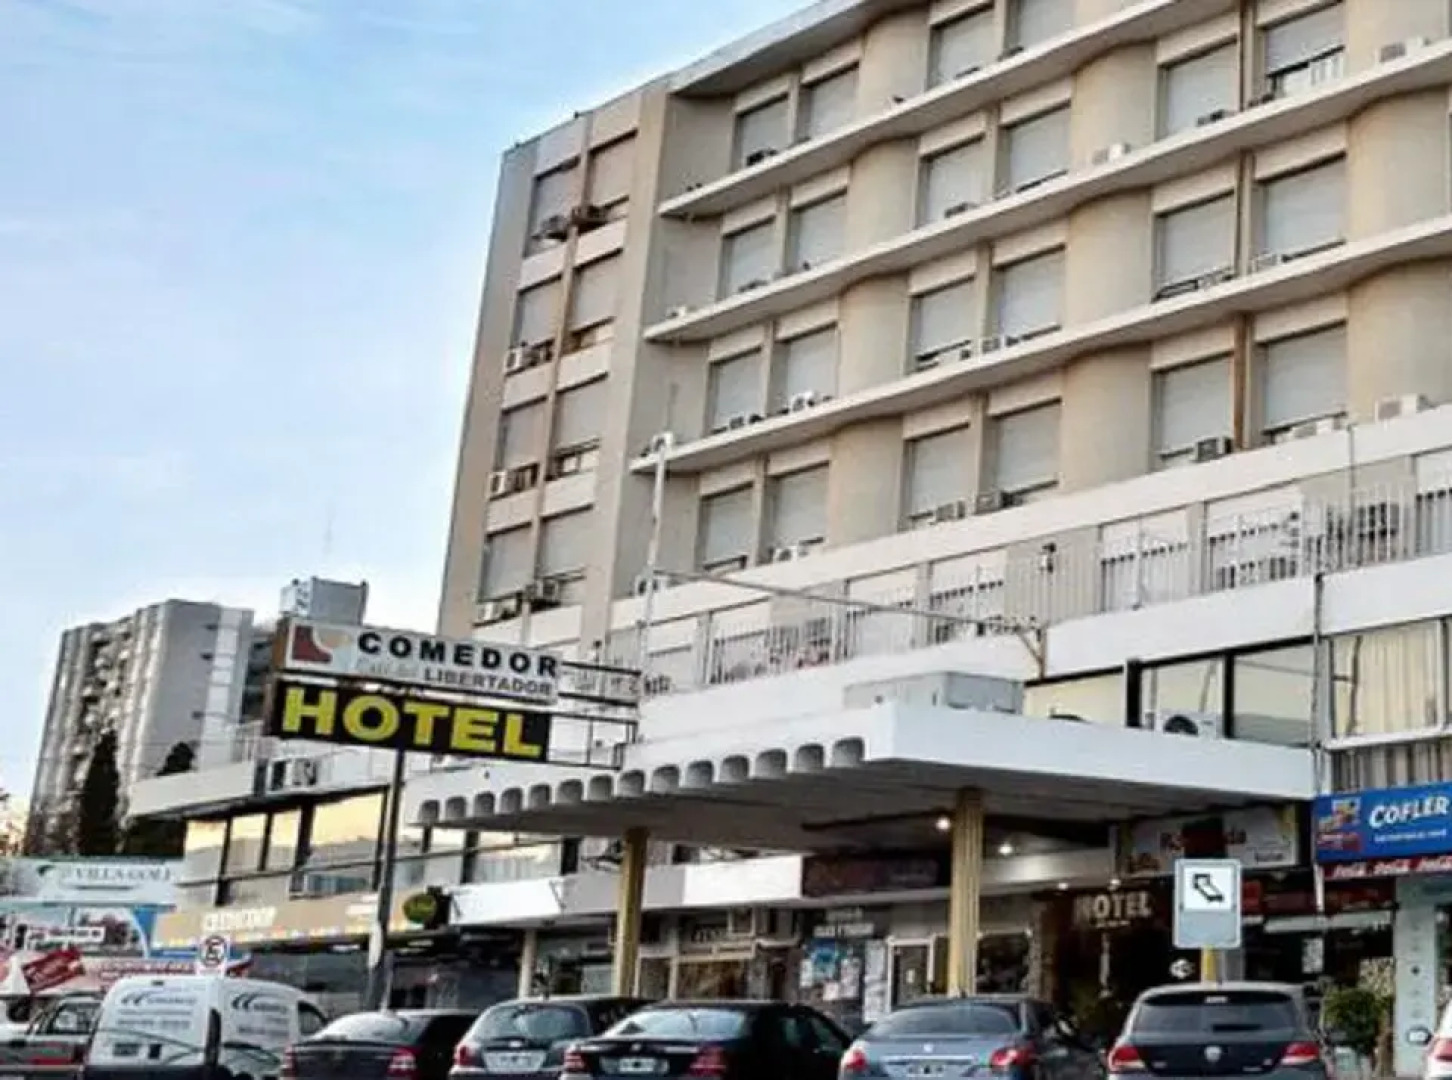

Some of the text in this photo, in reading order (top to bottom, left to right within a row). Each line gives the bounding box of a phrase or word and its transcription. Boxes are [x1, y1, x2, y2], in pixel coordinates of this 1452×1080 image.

[357, 631, 558, 678] COMEDOR
[424, 667, 551, 695] LIBERTADOR
[282, 685, 543, 758] HOTEL
[1368, 795, 1450, 828] COFLER
[1073, 891, 1152, 920] HOTEL
